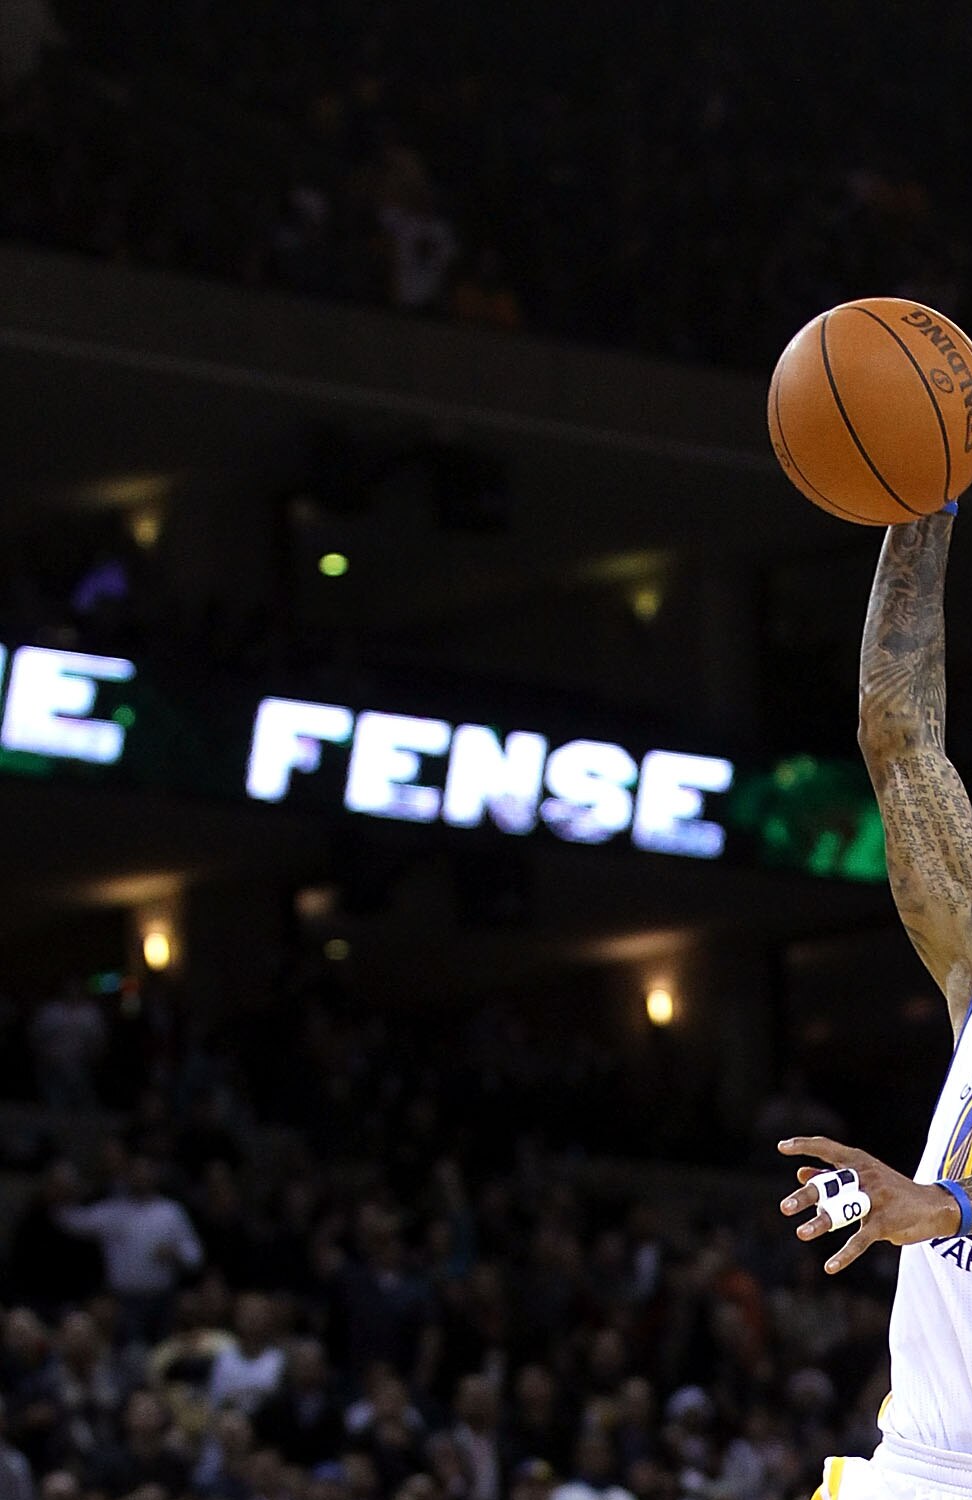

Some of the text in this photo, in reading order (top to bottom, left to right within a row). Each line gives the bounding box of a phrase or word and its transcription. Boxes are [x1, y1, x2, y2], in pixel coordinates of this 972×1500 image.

[0, 642, 137, 765] E
[245, 695, 734, 859] FENSE
[842, 1202, 862, 1221] 8
